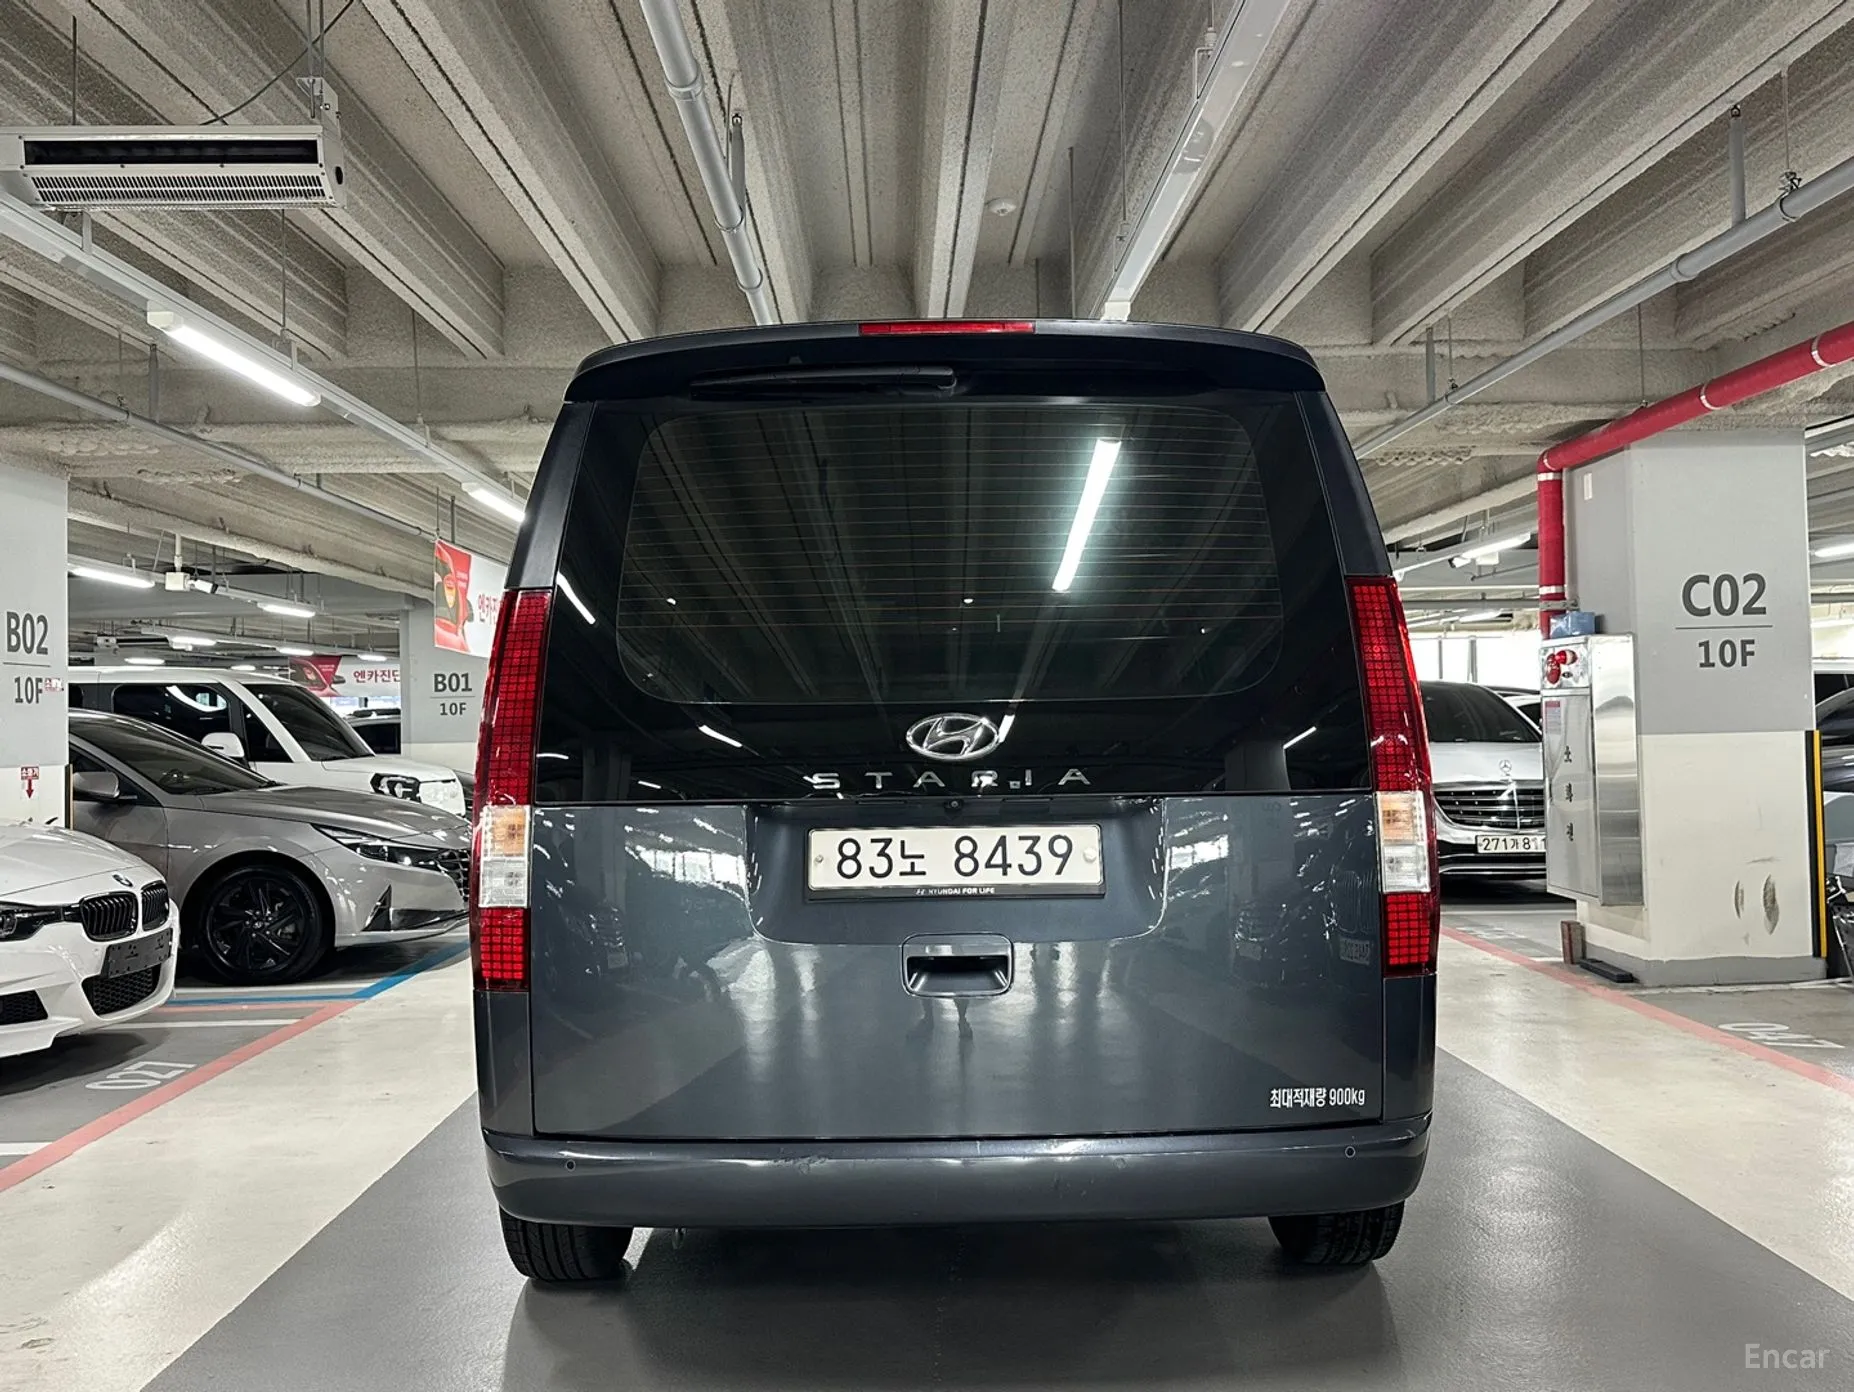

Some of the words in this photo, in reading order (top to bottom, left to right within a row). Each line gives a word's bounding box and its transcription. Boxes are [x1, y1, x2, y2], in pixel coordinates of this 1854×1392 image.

[1682, 573, 1766, 617] C02
[6, 611, 48, 655] B02
[1698, 639, 1755, 668] 10F
[14, 676, 43, 704] 10F
[434, 673, 472, 692] B01
[440, 702, 467, 716] 10F
[809, 767, 1091, 790] STARIA
[837, 837, 926, 879] 83노
[954, 835, 1074, 877] 8439
[962, 887, 978, 895] FOR
[85, 1061, 198, 1090] 027
[1270, 1087, 1327, 1108] 최대적재량
[1329, 1087, 1366, 1106] 900kg
